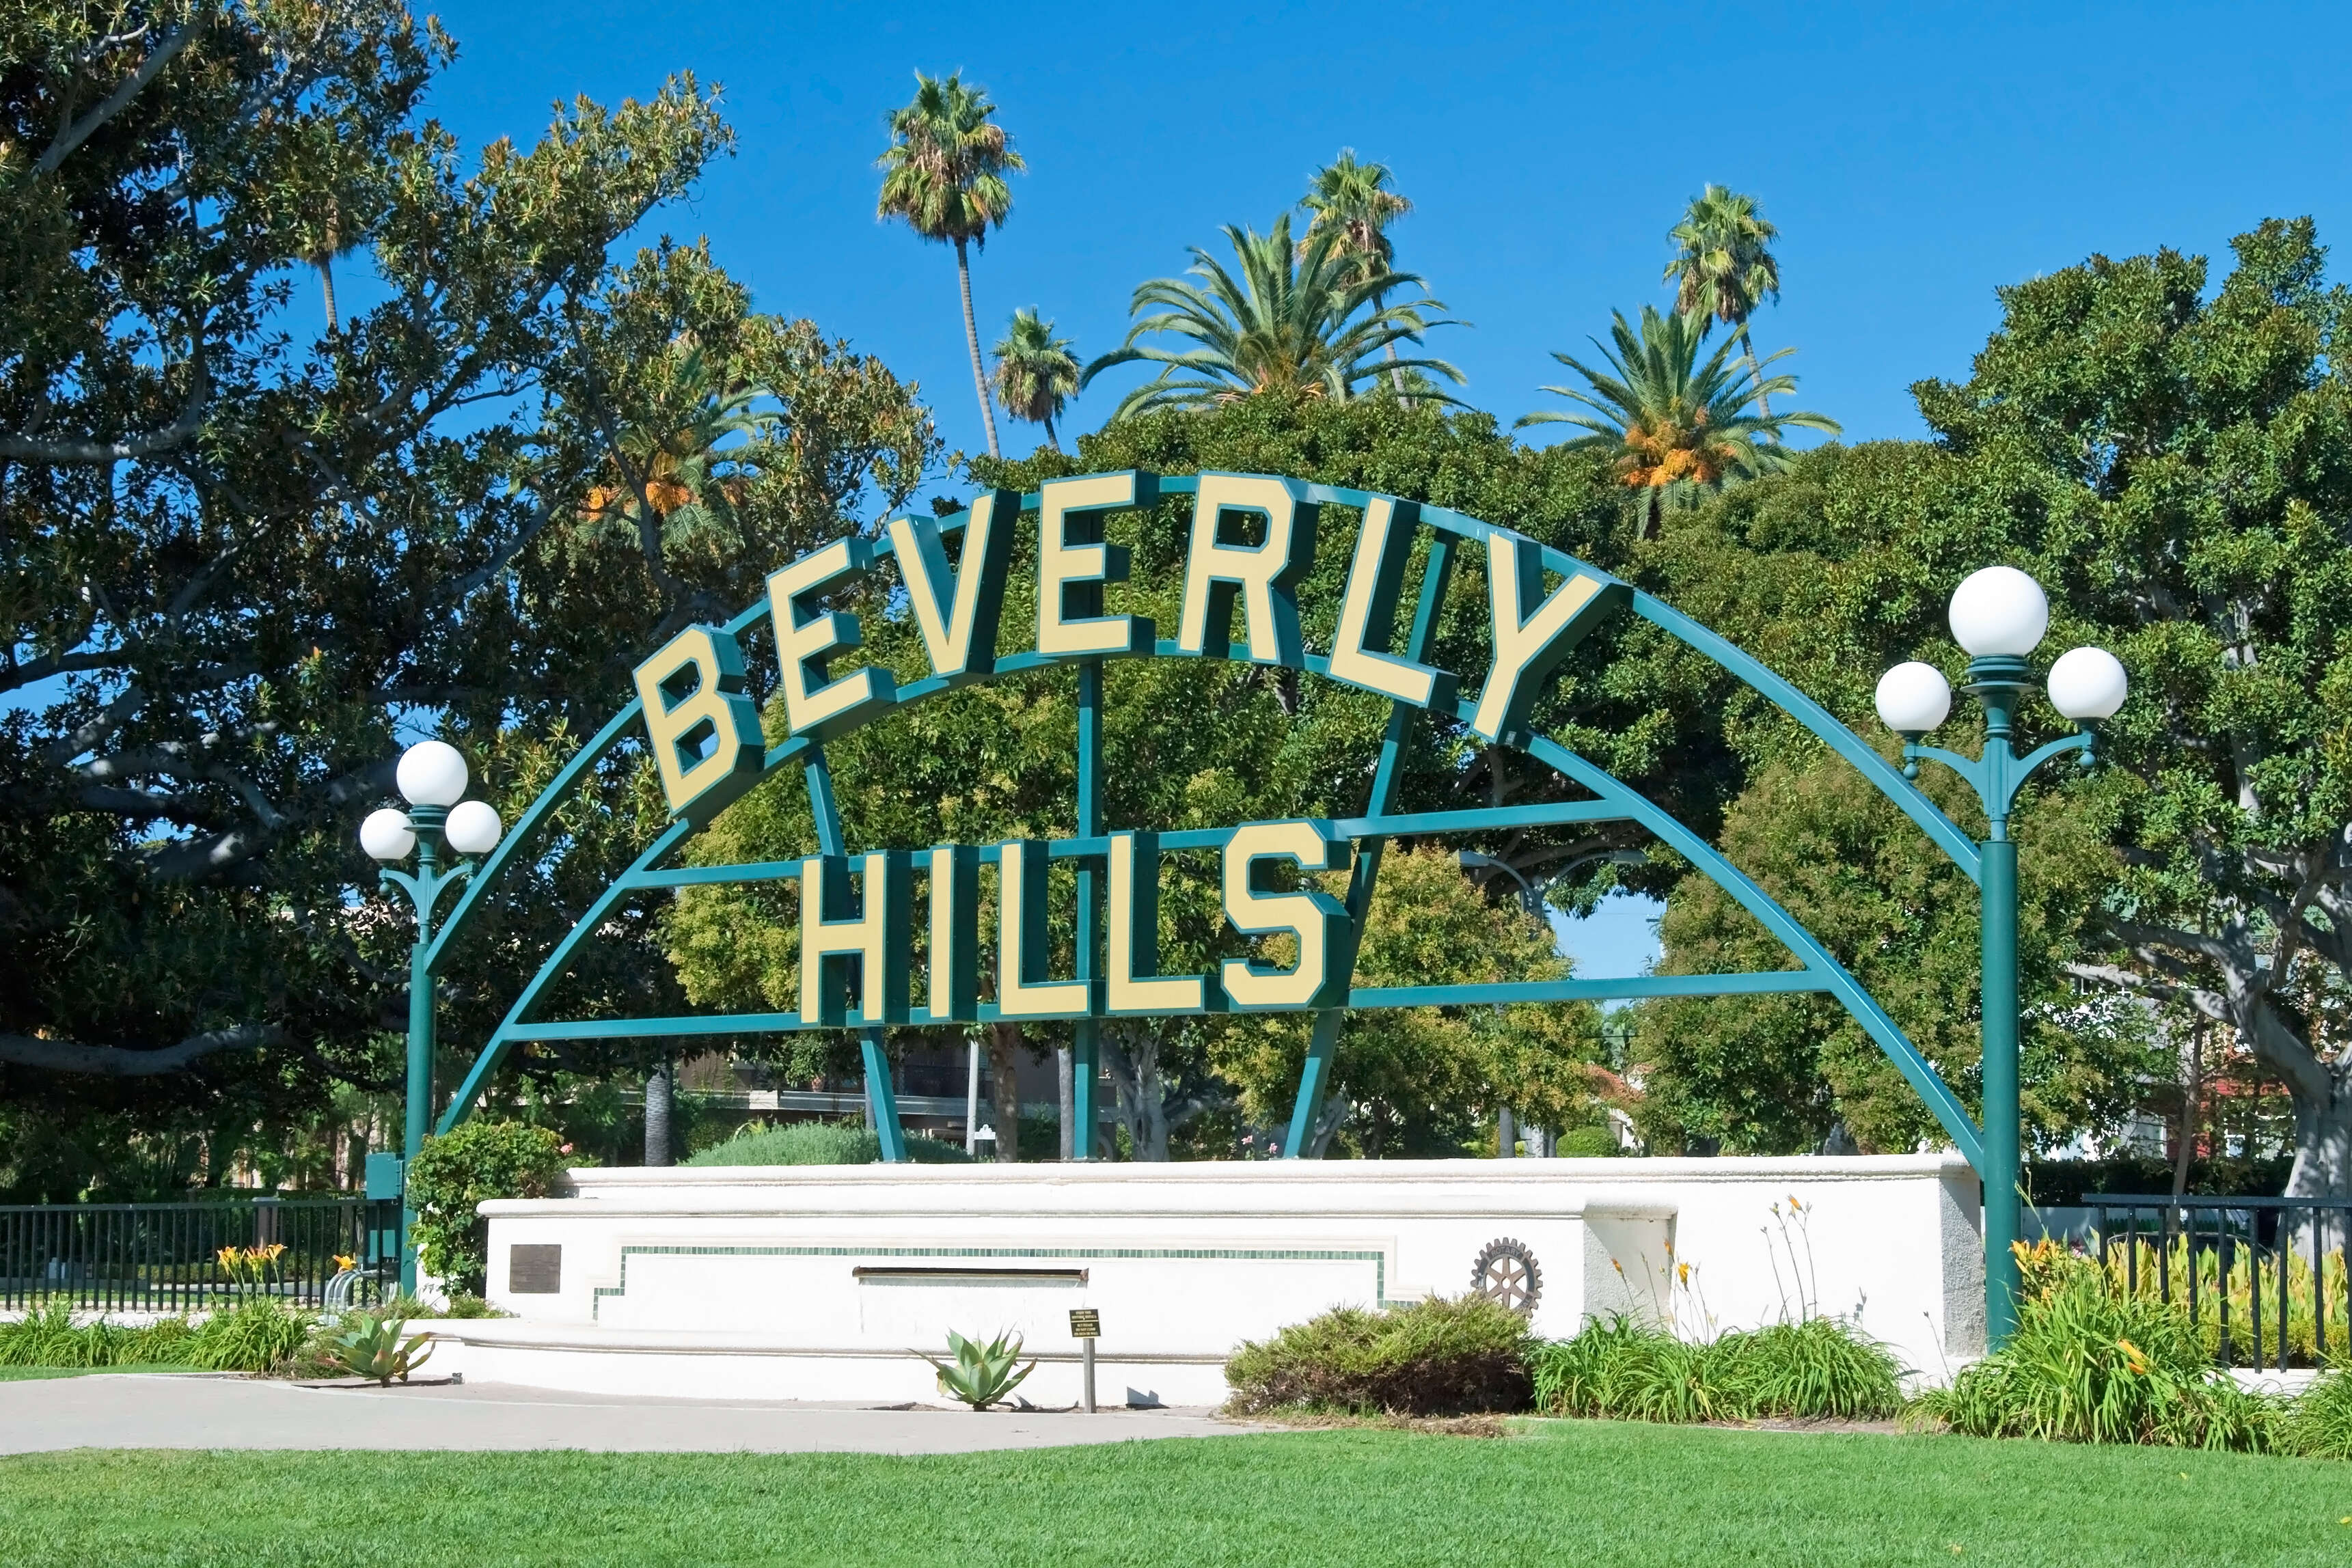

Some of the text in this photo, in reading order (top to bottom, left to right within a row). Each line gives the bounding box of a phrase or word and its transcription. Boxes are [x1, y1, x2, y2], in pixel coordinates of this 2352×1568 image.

[633, 469, 1611, 817] BEVERLY
[800, 819, 1328, 1026] HILLS
[1492, 1246, 1520, 1257] ROTARY
